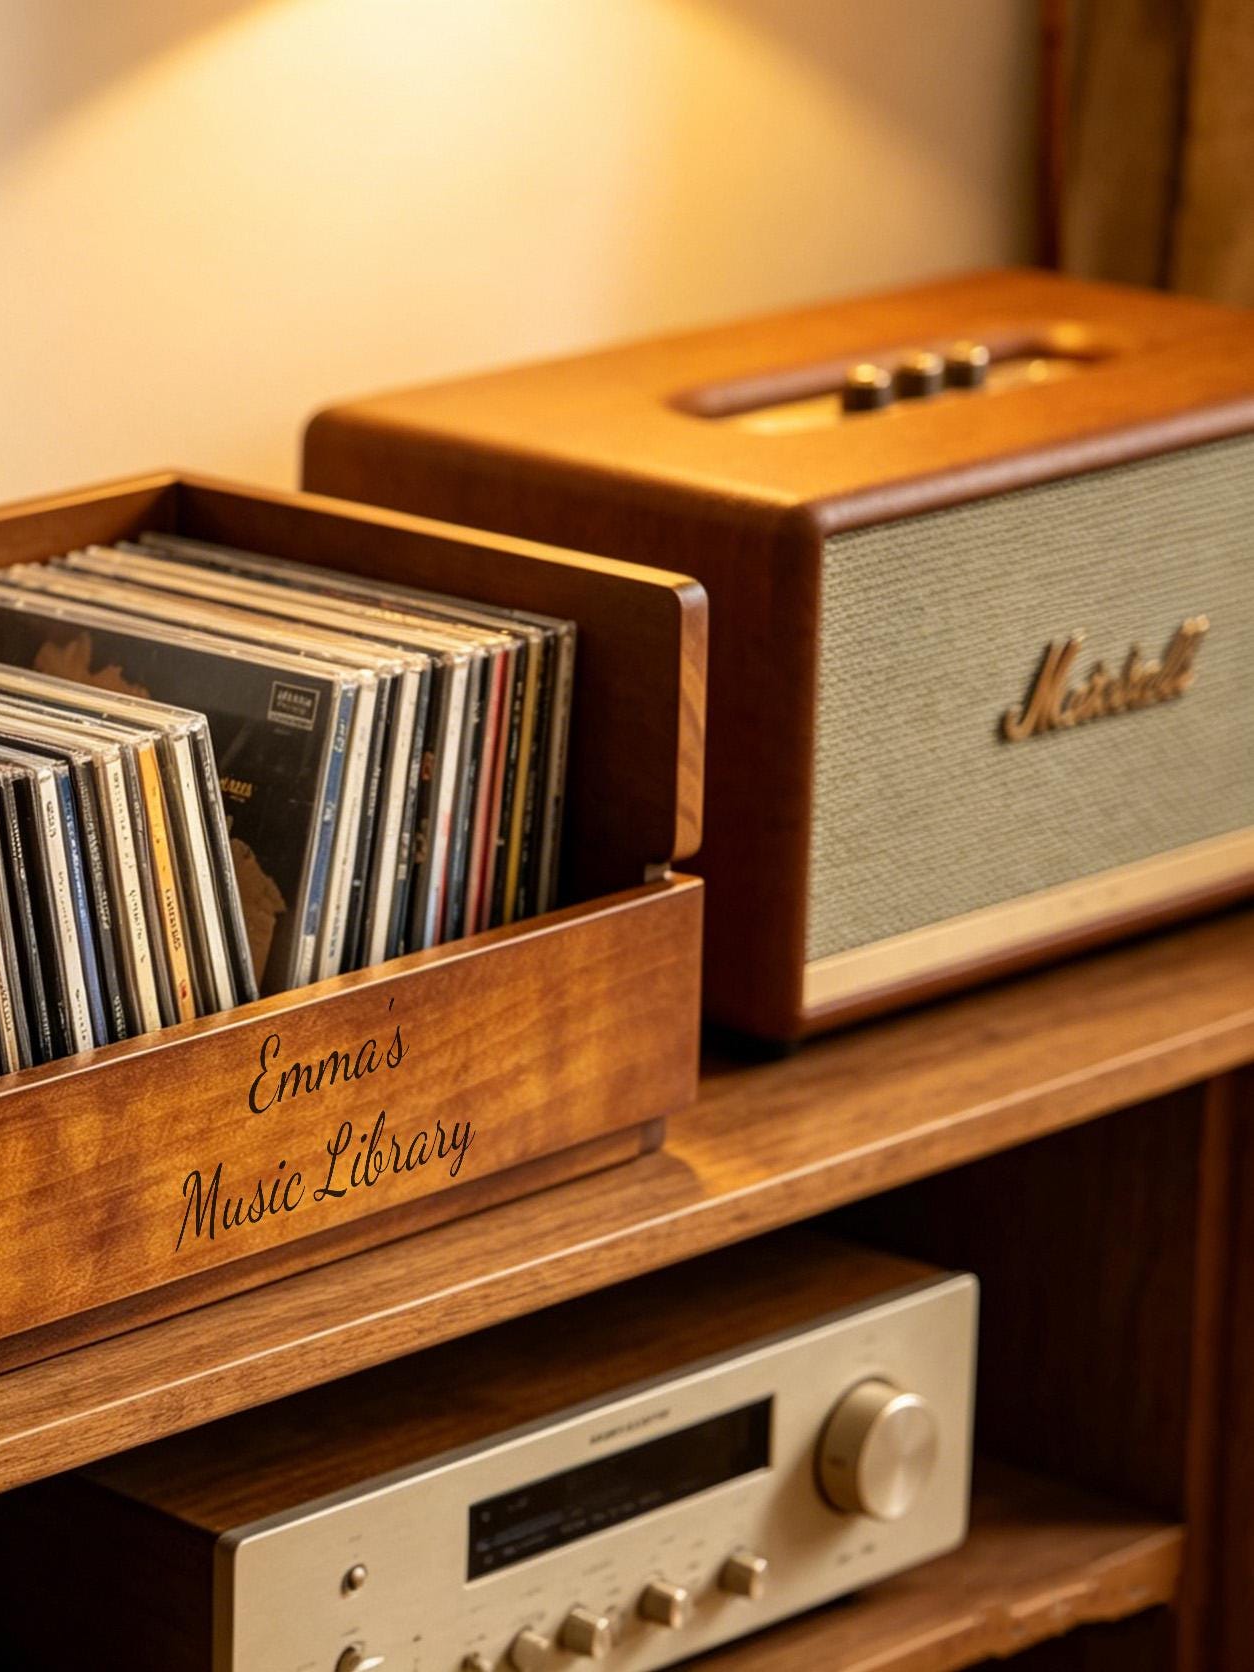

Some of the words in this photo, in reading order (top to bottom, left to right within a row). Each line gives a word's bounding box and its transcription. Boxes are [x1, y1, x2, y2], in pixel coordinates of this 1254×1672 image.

[248, 997, 410, 1114] Emma's
[176, 1161, 306, 1253] Music
[313, 1111, 476, 1202] Library
